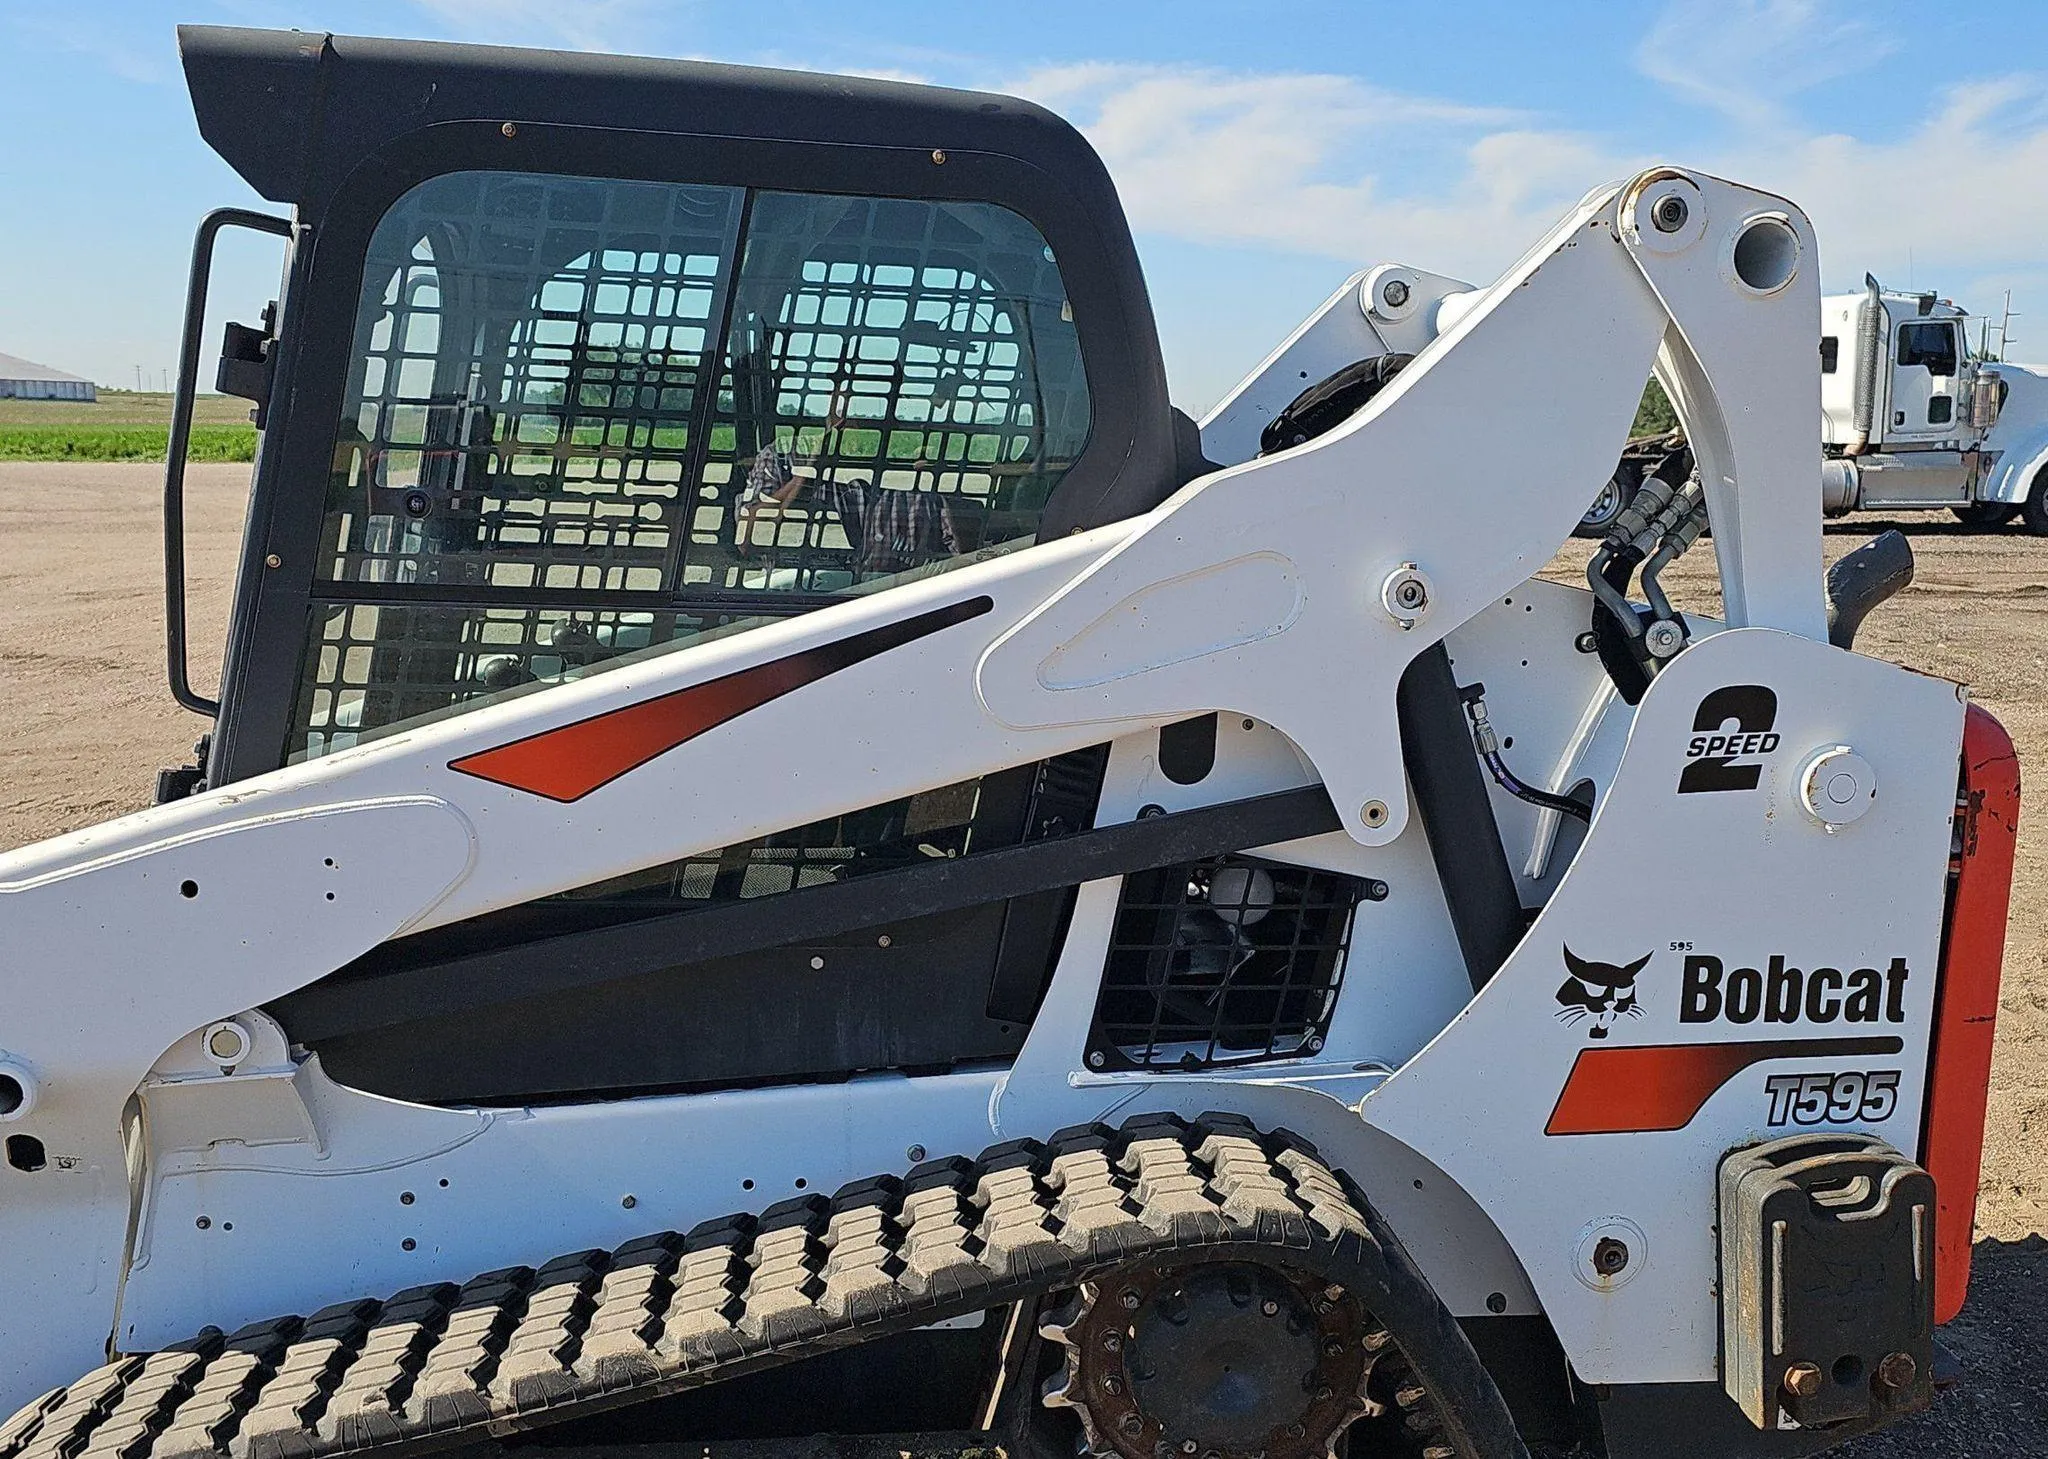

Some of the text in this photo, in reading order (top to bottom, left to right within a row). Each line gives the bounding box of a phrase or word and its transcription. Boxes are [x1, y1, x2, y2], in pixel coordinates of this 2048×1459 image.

[1678, 685, 1777, 794] 2
[1686, 733, 1780, 757] SPEED
[1669, 942, 1693, 951] 595
[1679, 955, 1908, 1024] Bobcat
[1764, 1070, 1902, 1127] T595
